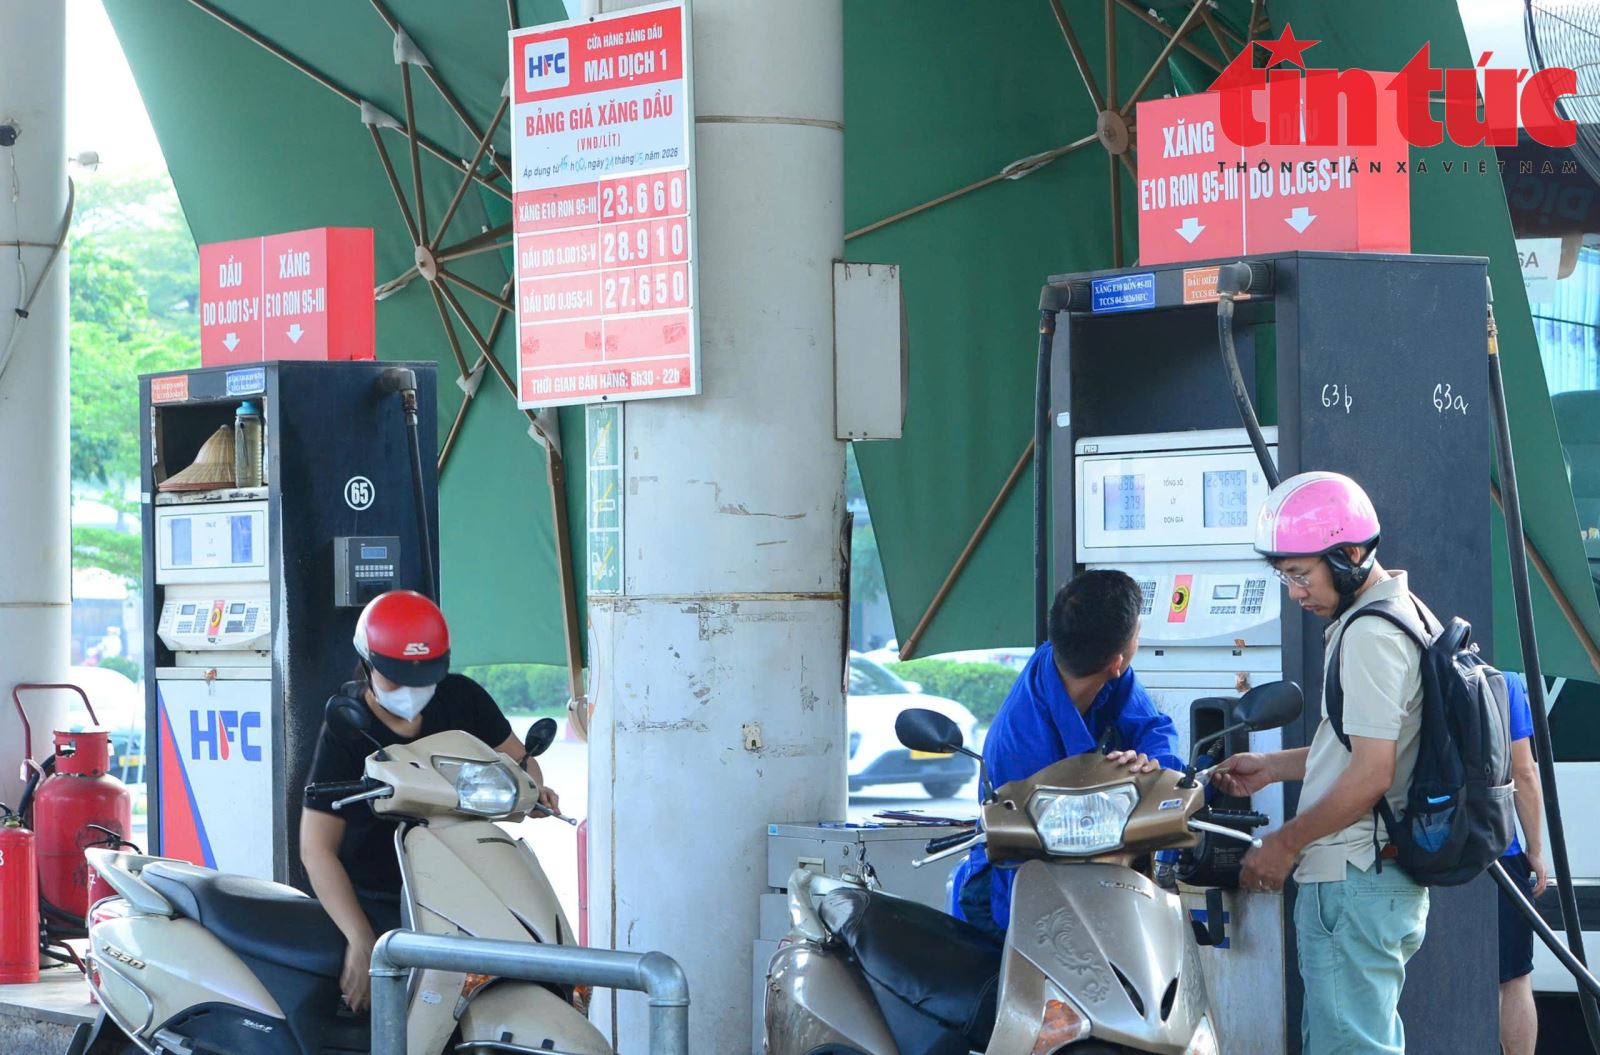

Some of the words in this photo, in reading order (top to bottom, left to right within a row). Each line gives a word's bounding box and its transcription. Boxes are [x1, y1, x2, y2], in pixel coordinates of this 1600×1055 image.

[587, 33, 602, 50] CỬA
[603, 32, 624, 47] HÀNG
[625, 28, 646, 44] XĂNG
[528, 52, 566, 78] HFC
[584, 57, 614, 83] MAI
[618, 50, 655, 80] DỊCH
[659, 48, 667, 71] 1
[526, 107, 565, 137] BẢNG
[569, 102, 594, 130] GIÁ
[598, 98, 638, 126] XĂNG
[643, 89, 673, 119] DẦU
[1163, 118, 1215, 158] XĂNG
[588, 157, 604, 171] ngày
[615, 154, 634, 166] tháng
[645, 150, 660, 161] năm
[661, 147, 679, 159] 2026
[1141, 178, 1165, 211] E10
[1170, 173, 1199, 207] RON
[1202, 167, 1239, 203] 95-III
[1250, 166, 1274, 200] DO
[1280, 156, 1351, 196] 0.05S-II
[519, 201, 540, 222] XĂNG
[542, 202, 556, 219] E10
[558, 199, 574, 218] RON
[576, 196, 597, 215] 95-III
[603, 177, 682, 218] 23.660
[542, 248, 554, 267] DO
[557, 244, 596, 265] 0.001S-V
[604, 224, 683, 263] 28.910
[279, 248, 310, 279] XĂNG
[265, 294, 281, 318] E10
[283, 290, 300, 316] RON
[302, 287, 325, 314] 95-III
[544, 292, 556, 311] DO
[558, 289, 593, 311] 0.05S-II
[605, 271, 684, 309] 27.650
[203, 302, 216, 326] DO
[218, 297, 259, 325] 0.001S-V
[532, 376, 552, 394] THỜI
[554, 376, 576, 393] GIAN
[578, 372, 598, 391] BÁN
[600, 369, 628, 389] HÀNG:
[630, 369, 654, 387] 6h30
[662, 368, 680, 385] 22h
[351, 483, 369, 504] 65
[190, 710, 262, 761] HFC
